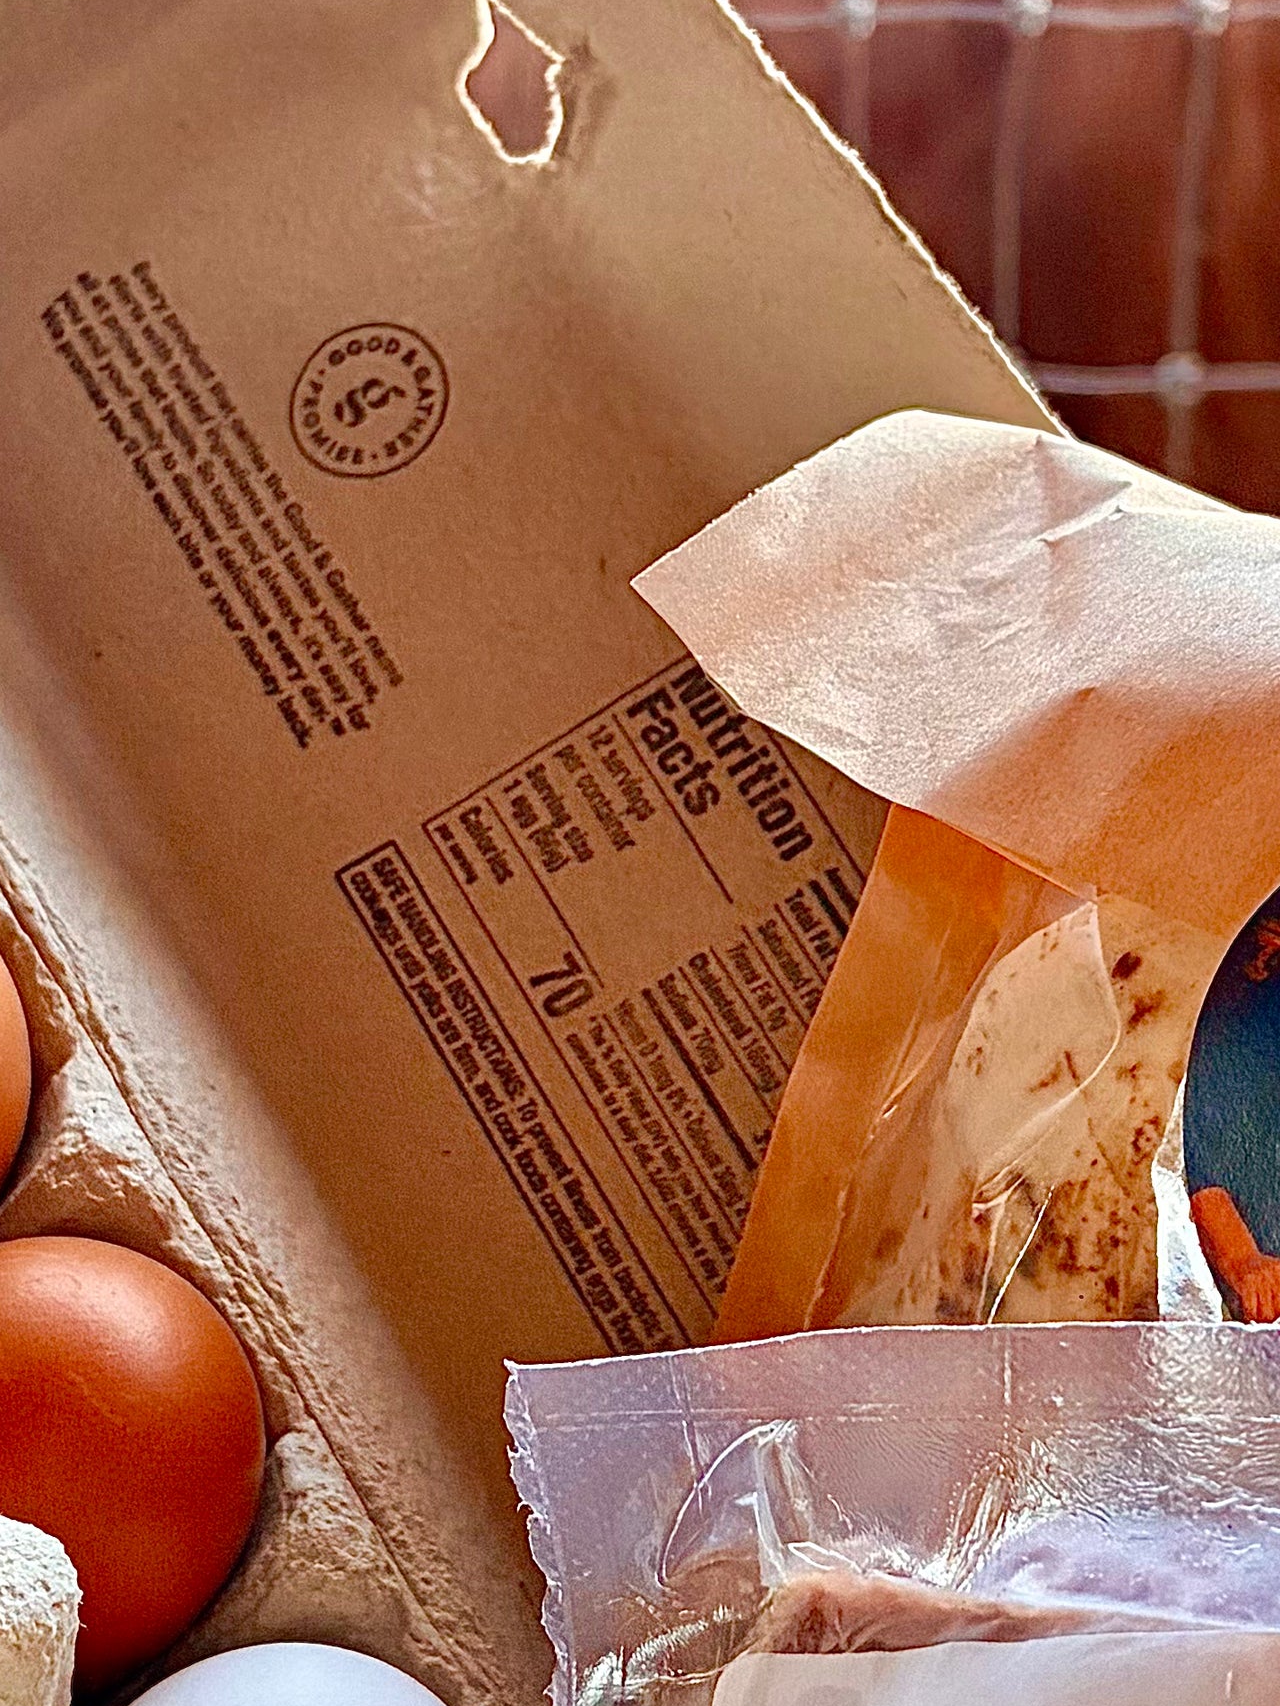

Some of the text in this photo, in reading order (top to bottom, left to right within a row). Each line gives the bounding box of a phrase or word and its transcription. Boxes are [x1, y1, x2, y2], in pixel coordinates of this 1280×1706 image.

[302, 379, 364, 465] PROMISE
[328, 335, 400, 366] GOOD
[384, 365, 437, 457] GATHER
[97, 358, 134, 403] your
[160, 451, 181, 472] to
[262, 627, 307, 686] every
[260, 514, 292, 553] and
[281, 550, 324, 609] tastes
[263, 471, 291, 503] the
[281, 500, 323, 553] Good
[313, 549, 335, 571] &
[324, 567, 374, 635] Gather
[130, 453, 161, 491] love
[151, 486, 191, 535] each
[175, 531, 209, 571] bite
[197, 567, 221, 594] or
[209, 590, 245, 636] your
[234, 632, 285, 700] money
[206, 483, 247, 534] today
[236, 528, 270, 566] and
[315, 661, 352, 707] easy
[343, 701, 375, 735] for
[502, 777, 522, 793] 1
[552, 743, 636, 855] per container
[585, 722, 661, 829] 12 servings
[624, 684, 732, 821] Facts
[671, 669, 817, 863] Nutrition
[506, 793, 540, 830] egg
[523, 762, 598, 864] Serving size
[370, 854, 411, 902] SAFE
[457, 804, 597, 1022] Calories 70
[782, 887, 839, 961] Total Fat
[394, 895, 459, 983] HANDLING
[726, 941, 764, 986] Trans
[750, 980, 778, 1010] Fat
[442, 976, 530, 1103] INSTRUCTIONS:
[656, 972, 701, 1031] Sodium
[687, 950, 752, 1041] Cholesterol
[436, 1016, 462, 1046] are
[473, 1078, 505, 1114] and
[490, 1109, 526, 1151] cook
[513, 1146, 554, 1194] foods
[513, 1096, 543, 1125] To
[523, 1118, 574, 1182] prevent
[590, 1226, 627, 1269] from
